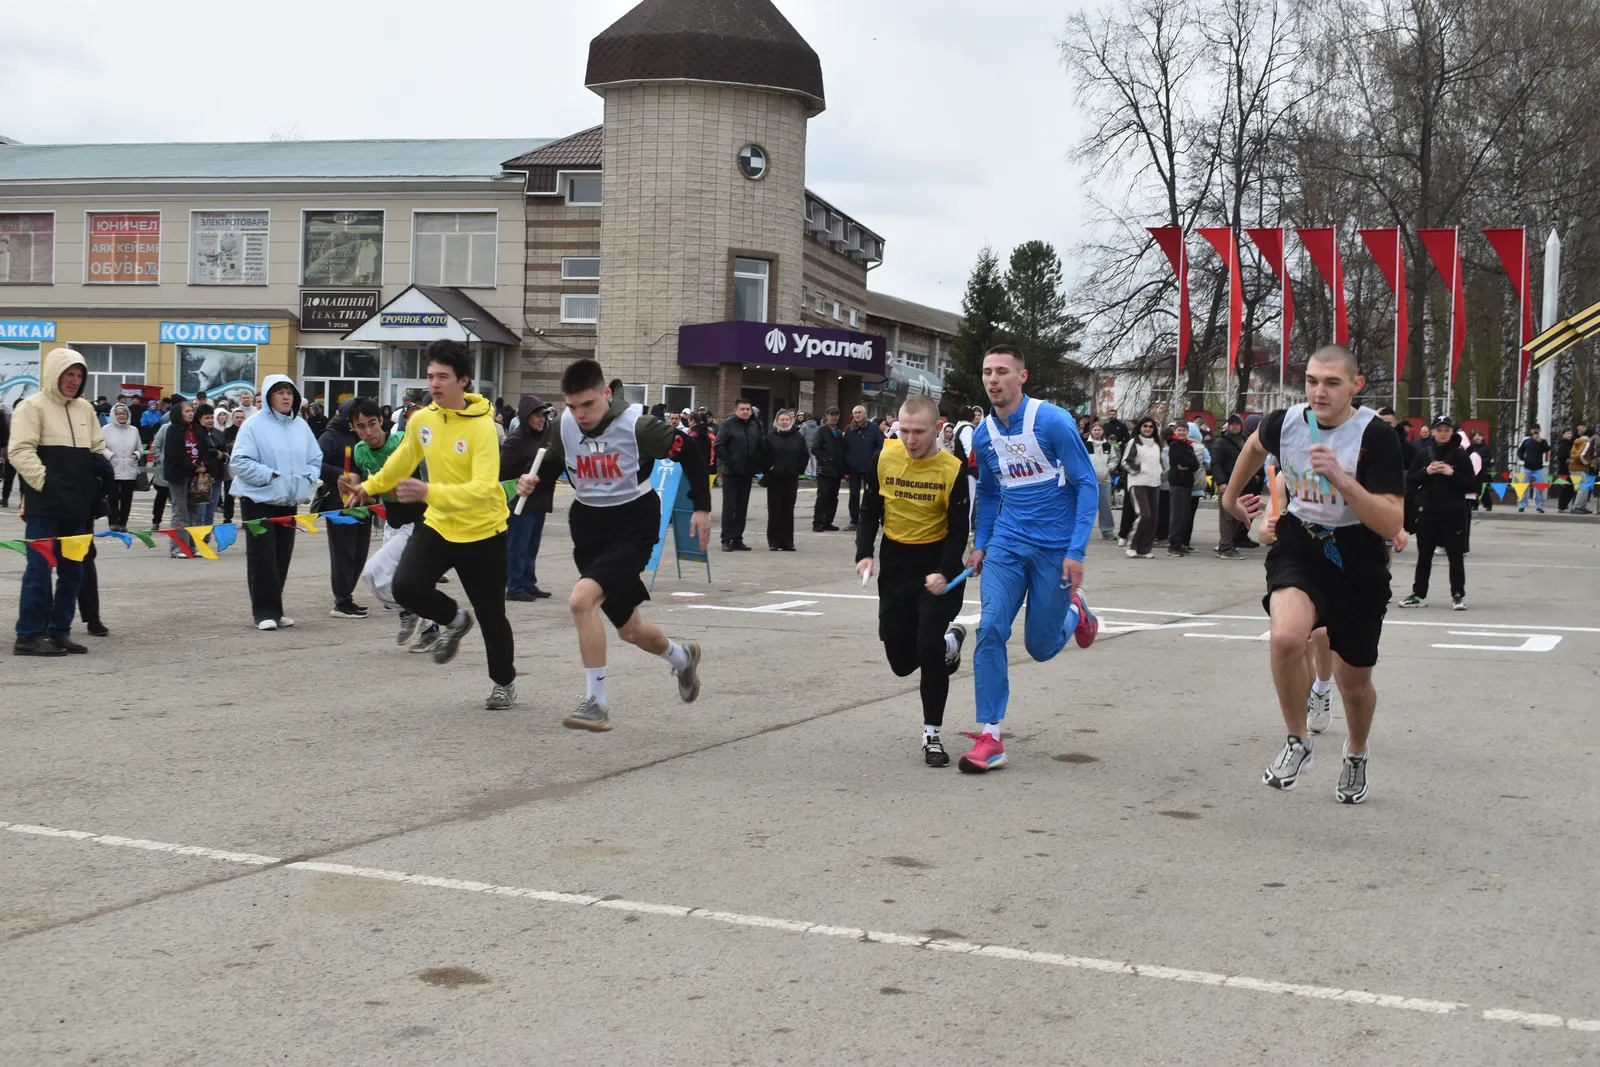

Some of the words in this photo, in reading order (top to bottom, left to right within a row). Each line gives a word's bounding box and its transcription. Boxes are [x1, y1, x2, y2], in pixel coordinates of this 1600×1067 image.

[97, 221, 158, 231] ЮНИЧЕЛ
[90, 261, 143, 275] ОБУВЬ
[304, 296, 375, 307] ДОМАШНИЙ
[381, 315, 421, 324] СРОЧНОЕ
[422, 315, 447, 324] ФОТО
[161, 324, 267, 341] КОЛОСОК
[792, 333, 873, 361] Уралсиб
[576, 453, 623, 479] МПК
[894, 490, 937, 501] сельсовет
